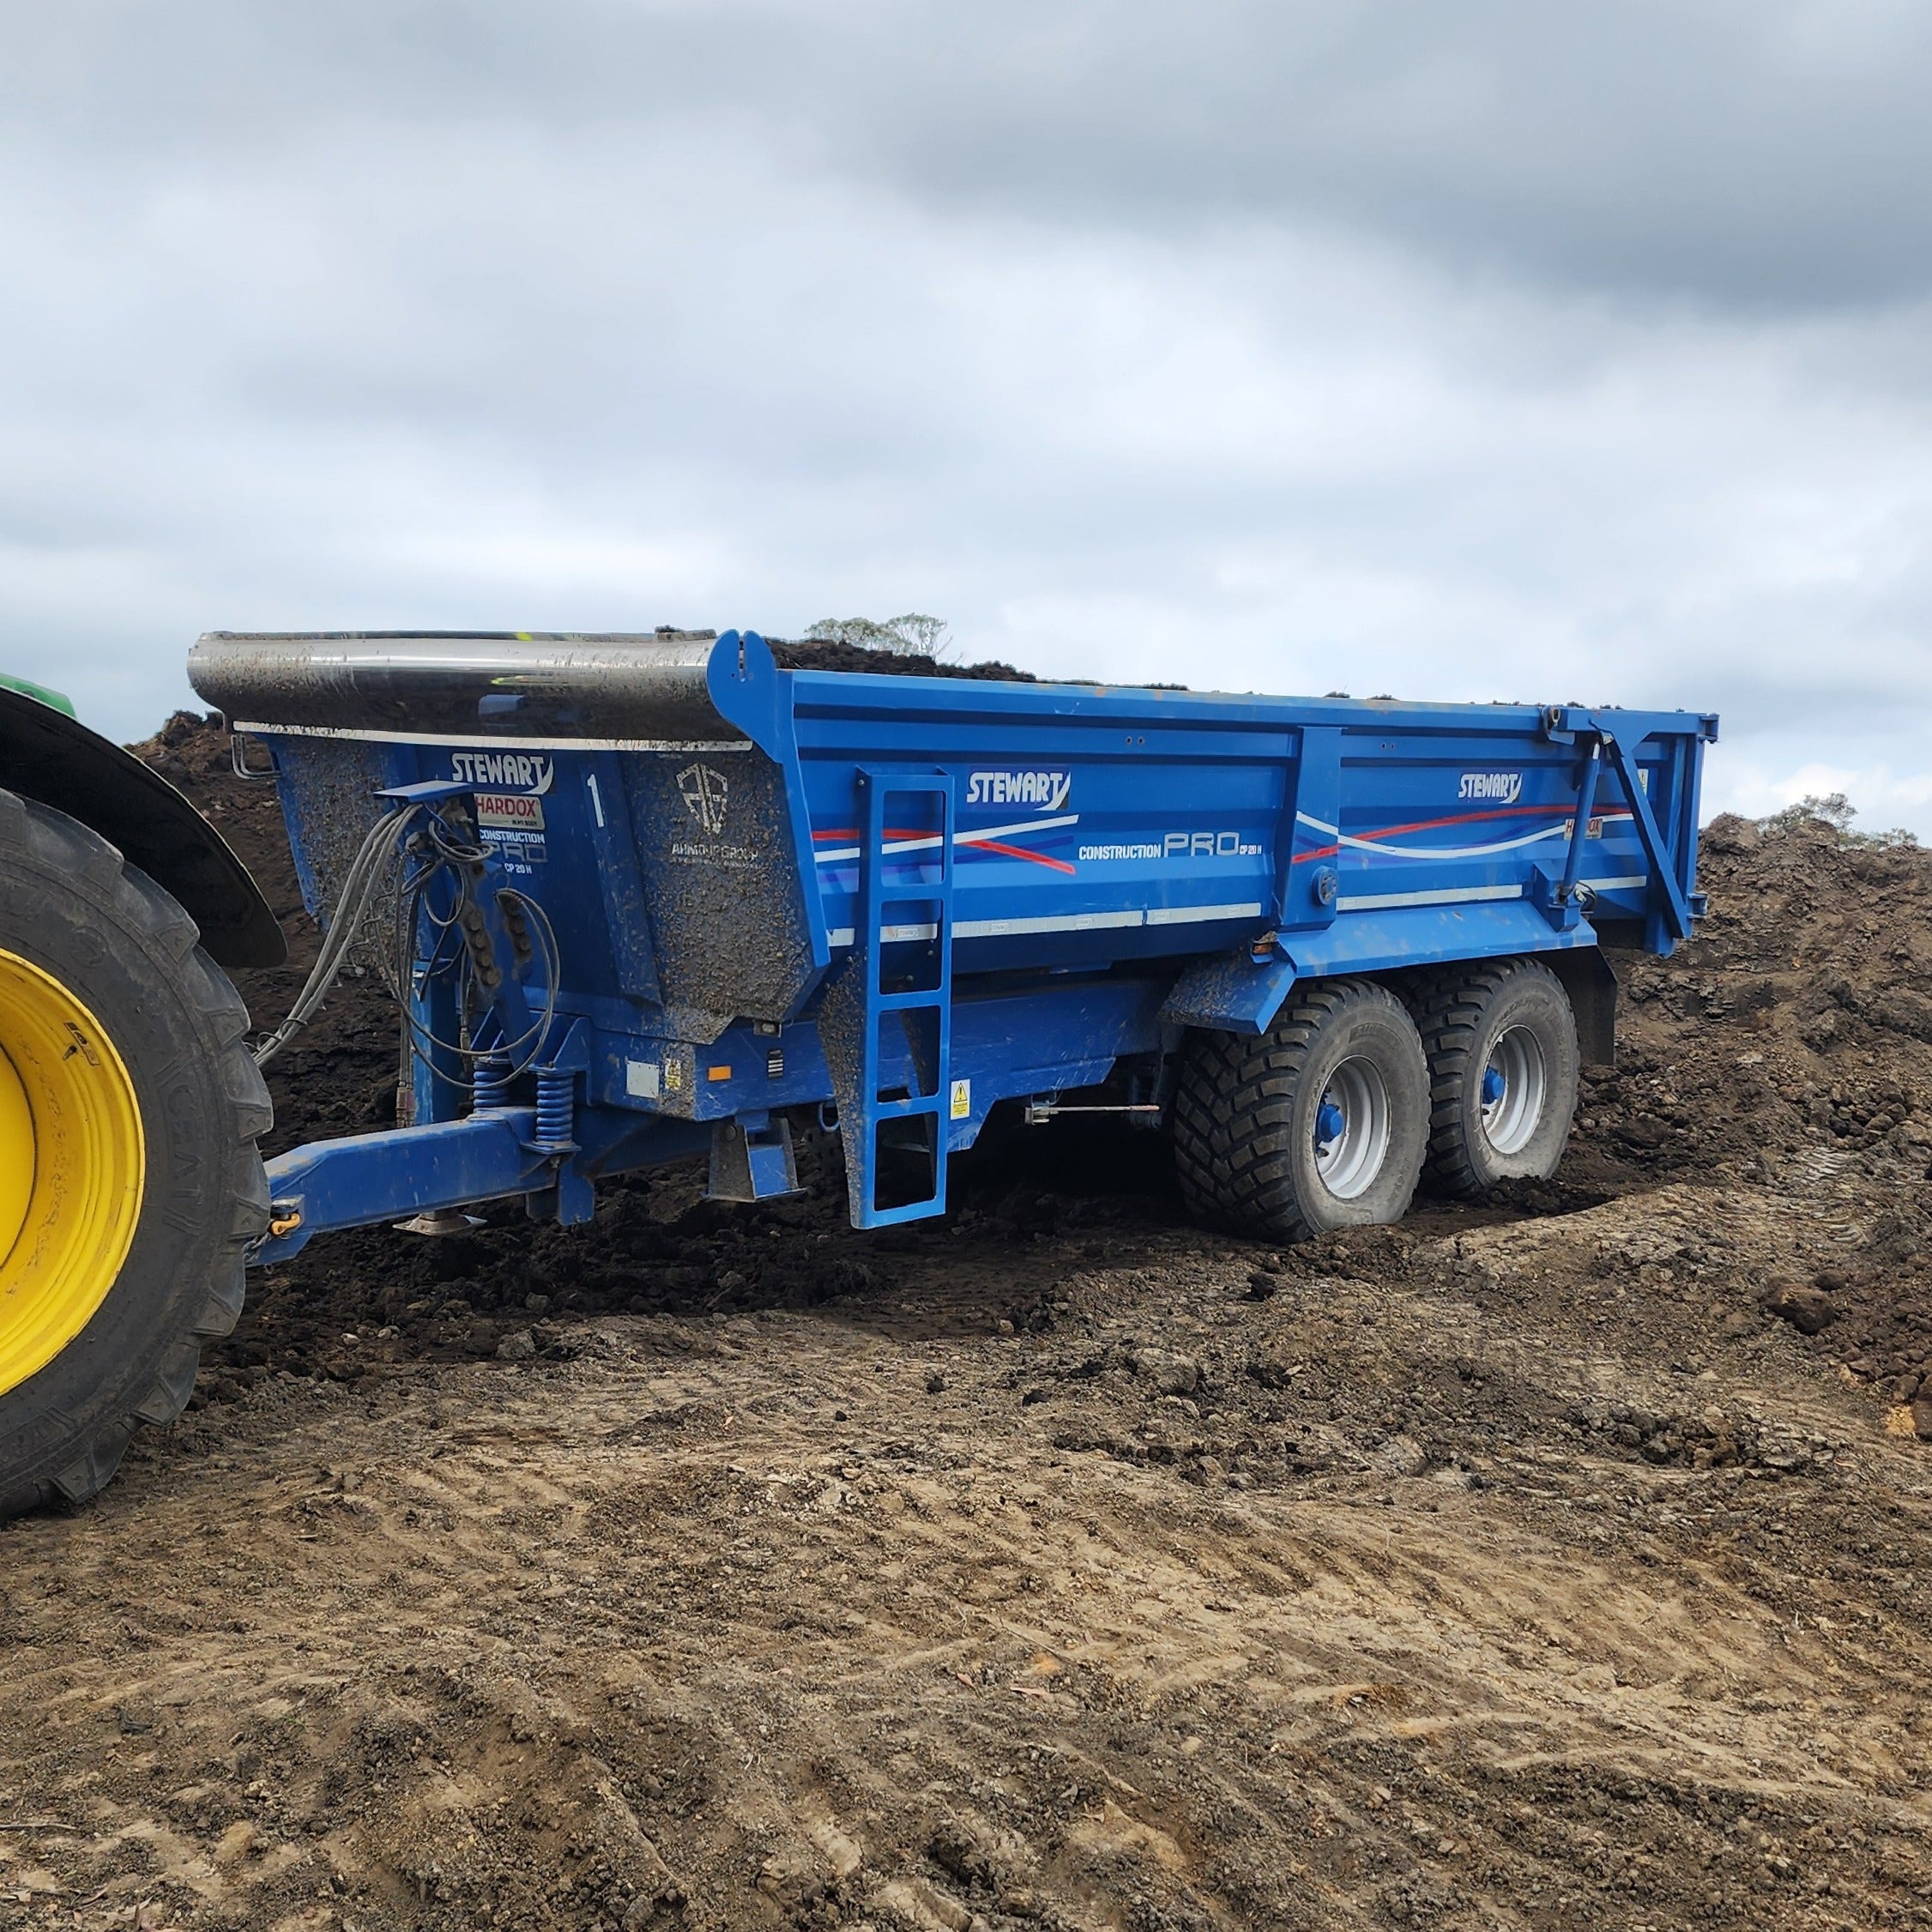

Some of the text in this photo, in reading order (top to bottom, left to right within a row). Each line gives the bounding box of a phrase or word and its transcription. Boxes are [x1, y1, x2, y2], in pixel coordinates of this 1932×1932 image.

[452, 752, 553, 794] STEWART
[966, 771, 1071, 811] STEWART
[1458, 772, 1523, 803] STEWART
[475, 796, 536, 818] HARDOX
[480, 829, 546, 844] CONSTRUCTION
[1567, 818, 1600, 833] HOX
[1078, 843, 1161, 860] CONSTRUCTION
[1164, 831, 1240, 858] PRO
[504, 862, 515, 873] CP
[515, 864, 526, 874] 20
